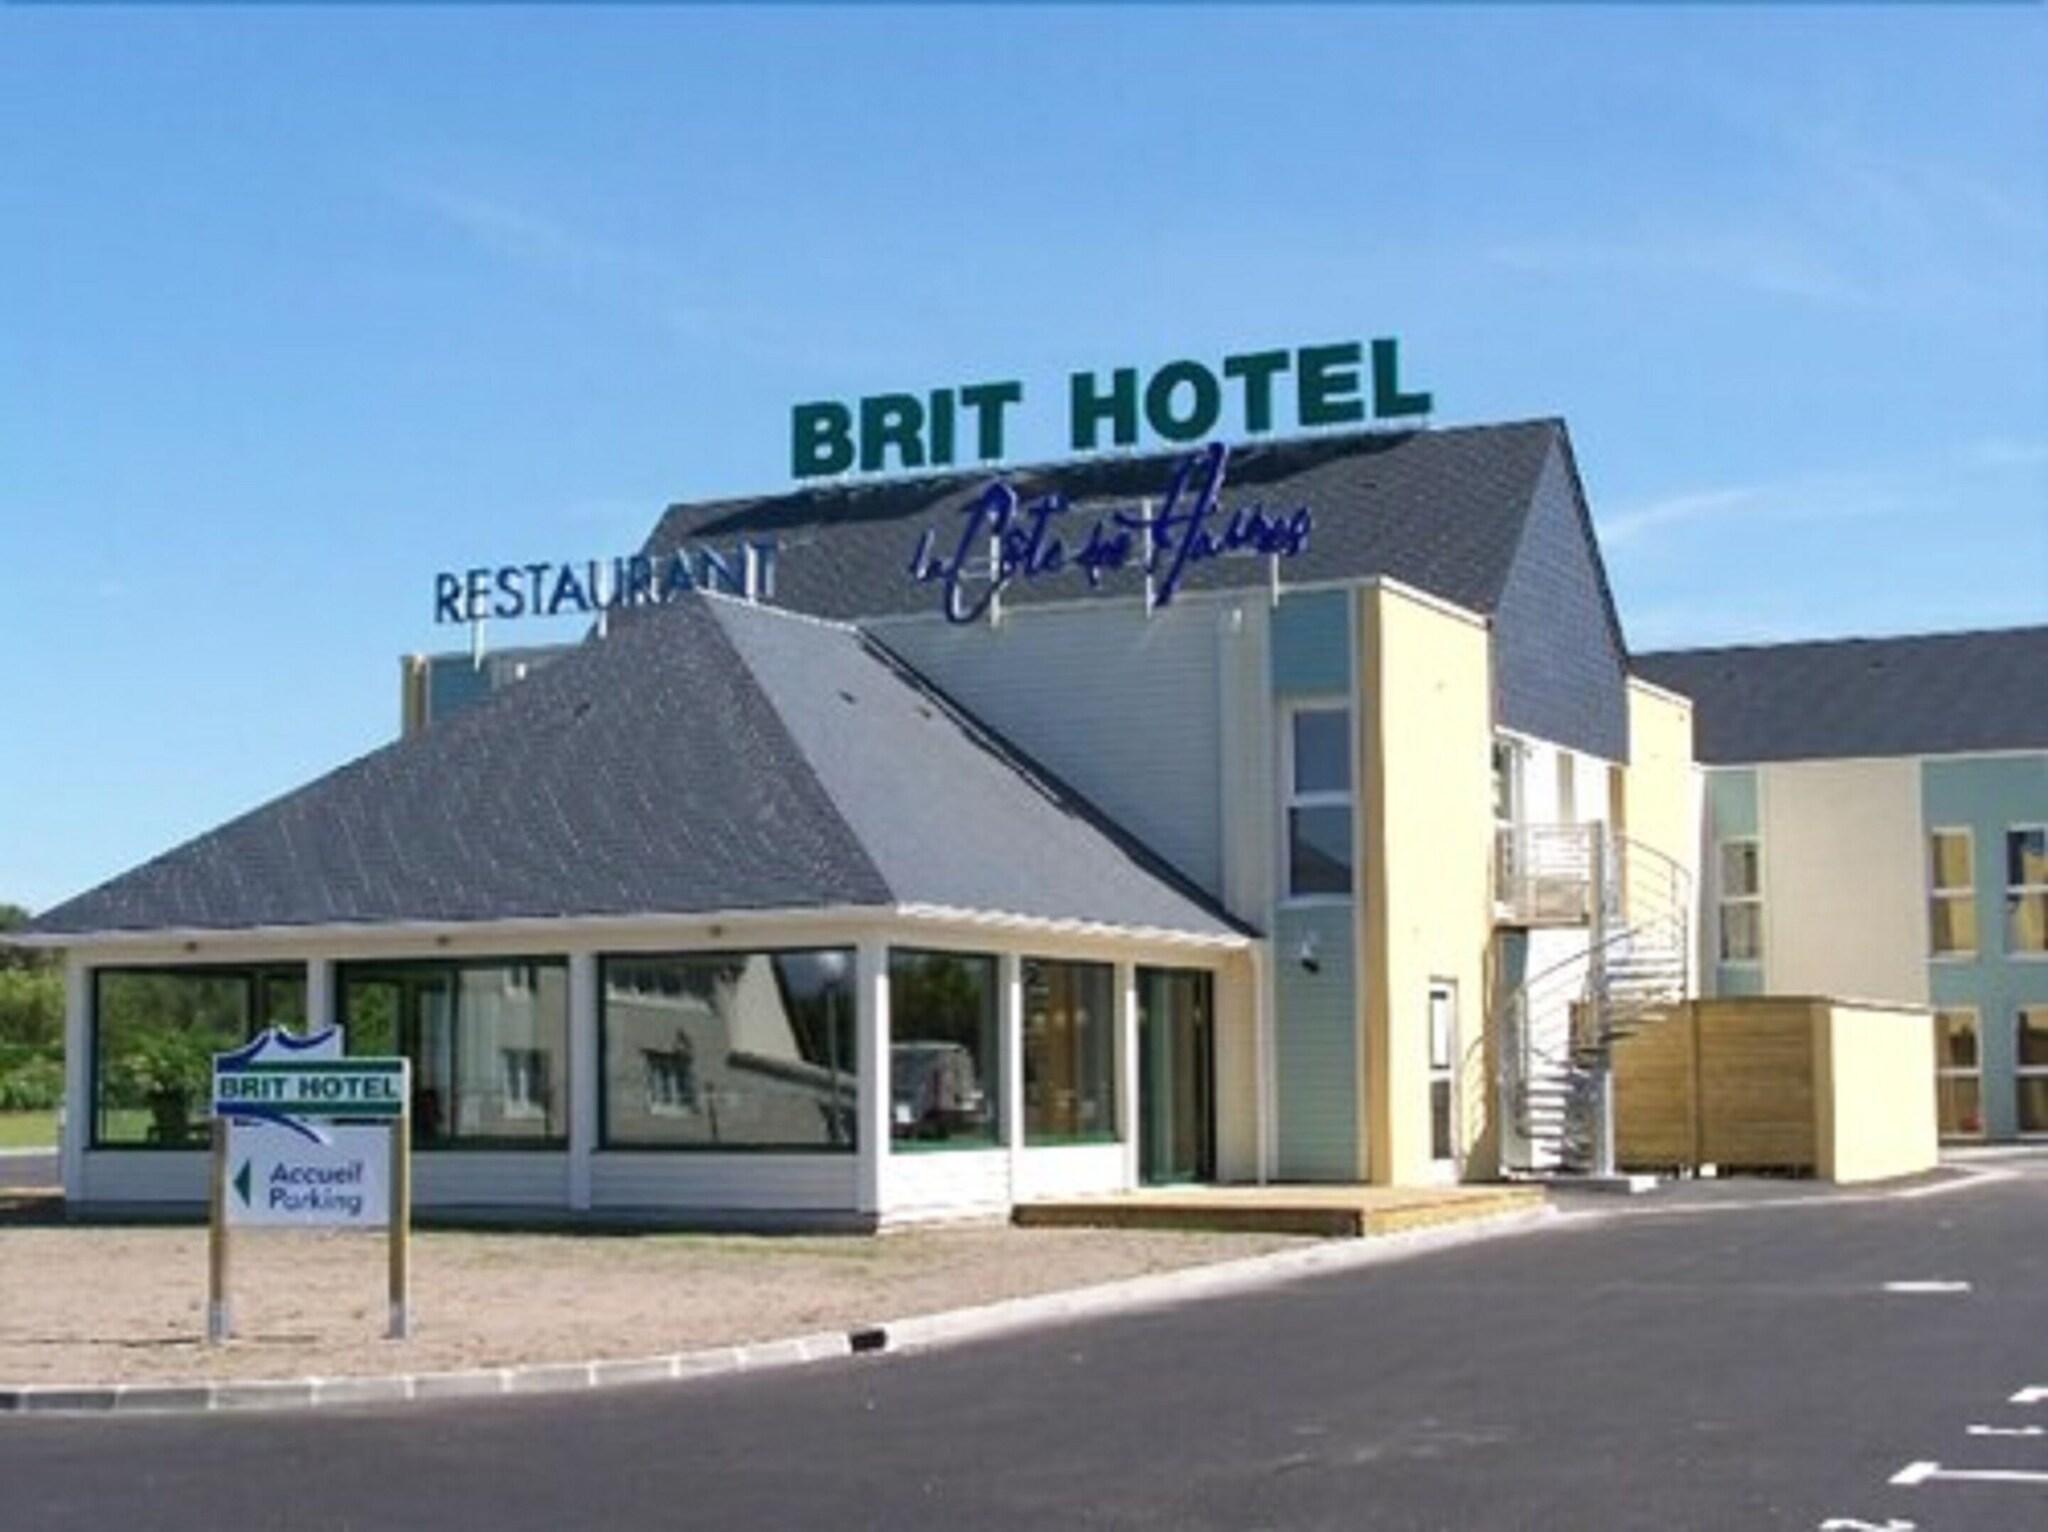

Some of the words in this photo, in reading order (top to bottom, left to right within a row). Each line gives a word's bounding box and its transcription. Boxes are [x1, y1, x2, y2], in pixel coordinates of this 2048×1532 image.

[791, 380, 1023, 480] BRIT
[1070, 337, 1433, 450] HOTEL
[433, 540, 778, 625] RESTAURANT
[219, 1076, 289, 1099] BRIT
[296, 1076, 399, 1099] HOTEL
[268, 1162, 364, 1185] Accueil
[268, 1187, 364, 1217] Parking
